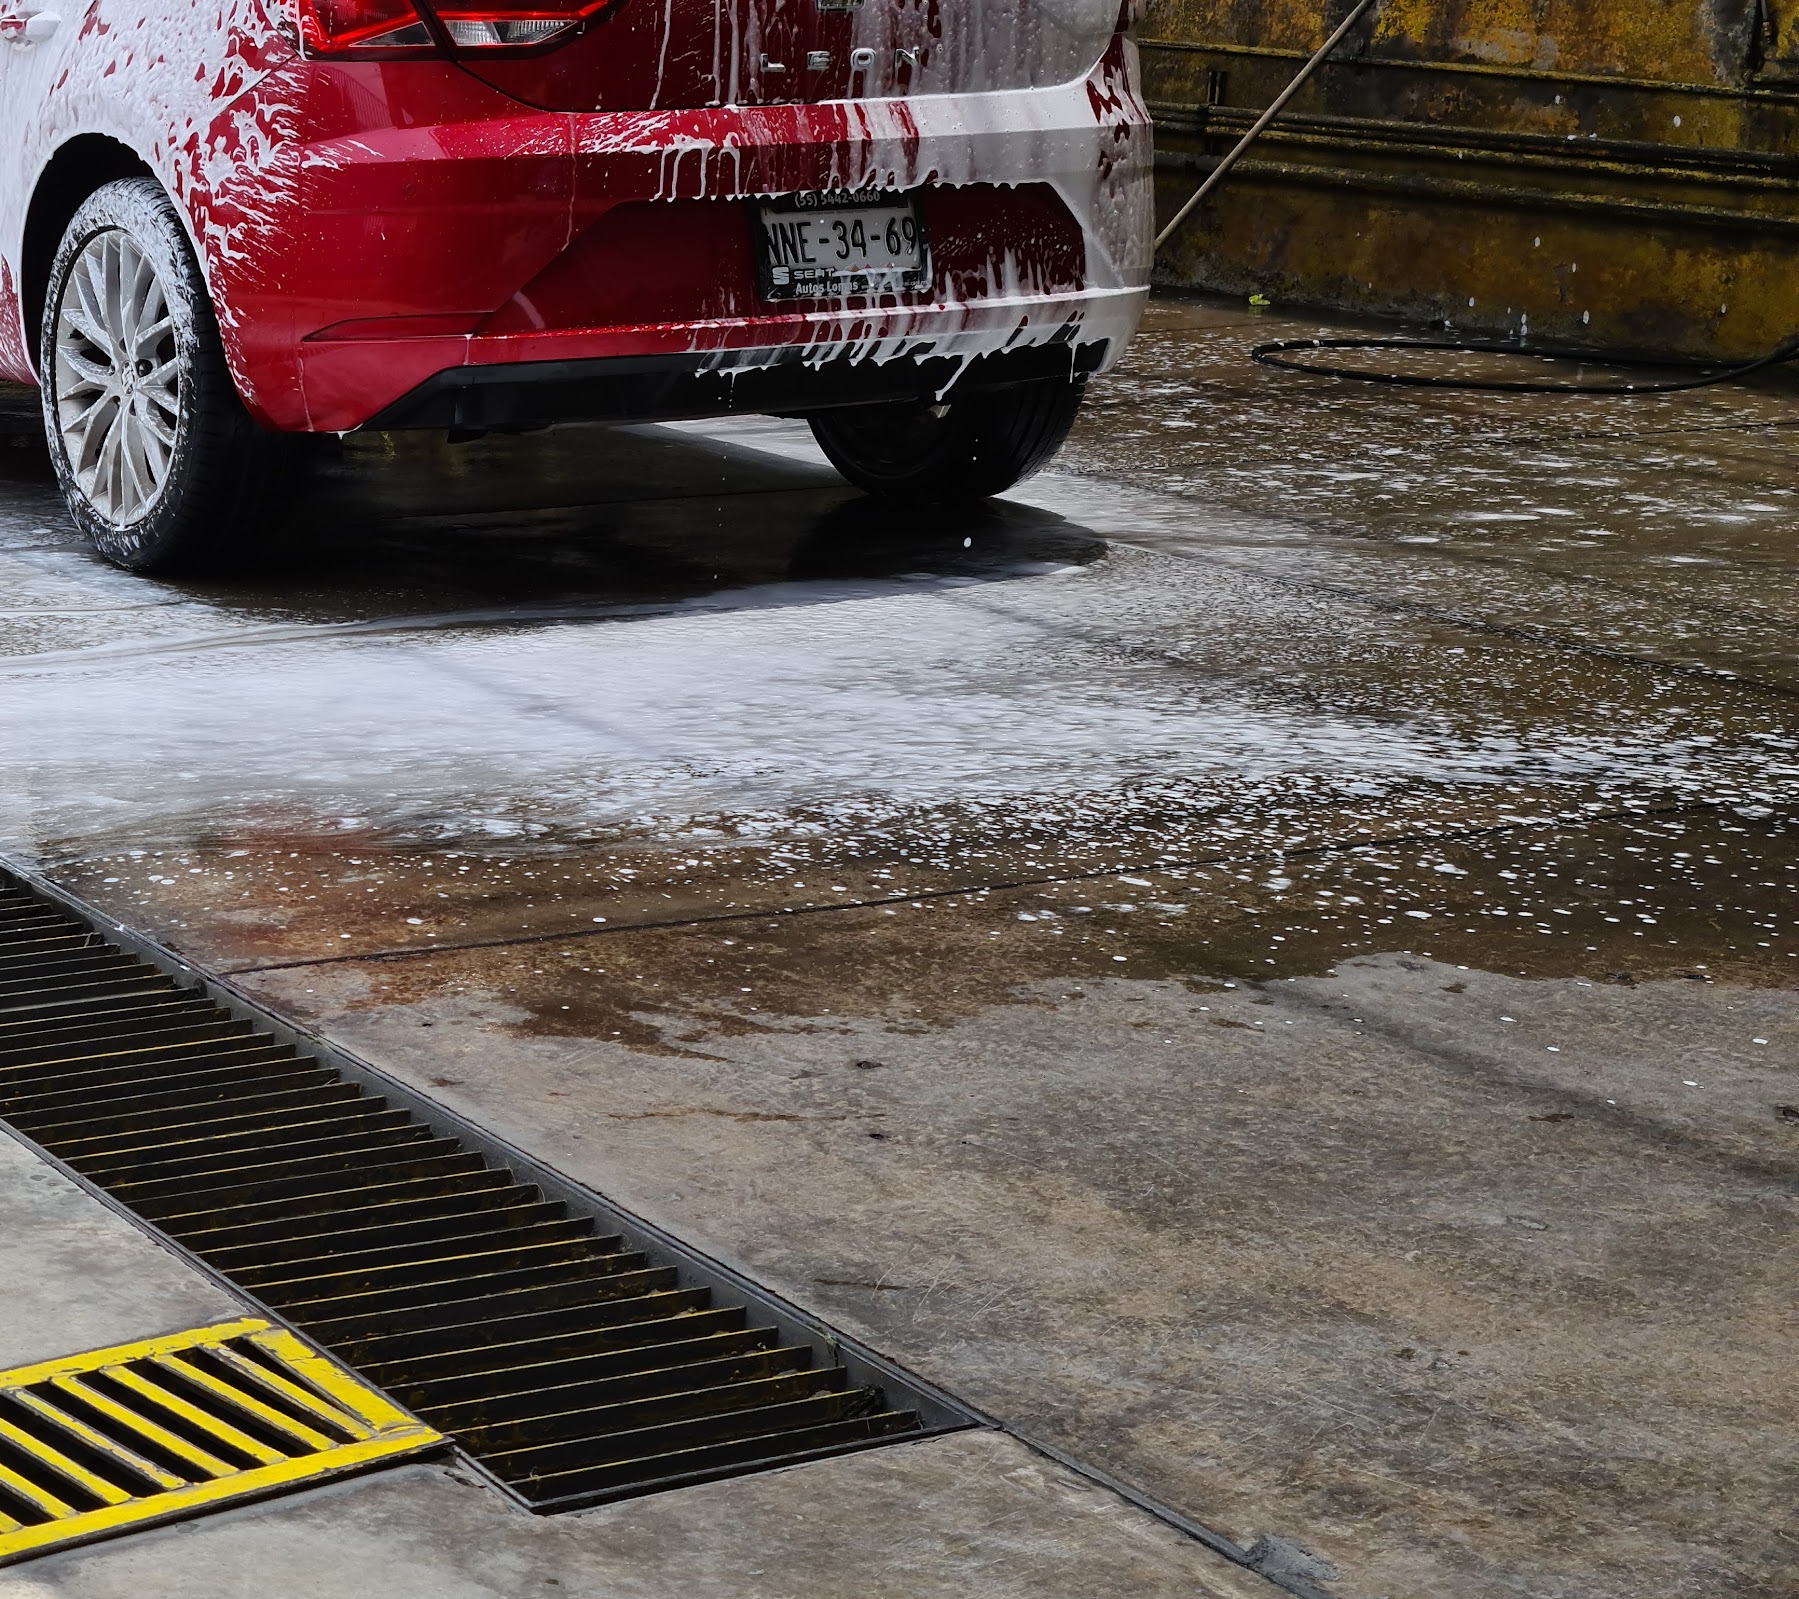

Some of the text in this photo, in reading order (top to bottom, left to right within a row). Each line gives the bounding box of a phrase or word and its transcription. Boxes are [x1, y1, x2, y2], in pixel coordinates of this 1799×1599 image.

[760, 46, 920, 72] LEON
[795, 190, 880, 208] (55) 5442-0660
[764, 216, 917, 265] NNE-34-69
[793, 268, 835, 280] SEAT
[795, 283, 824, 296] Autos
